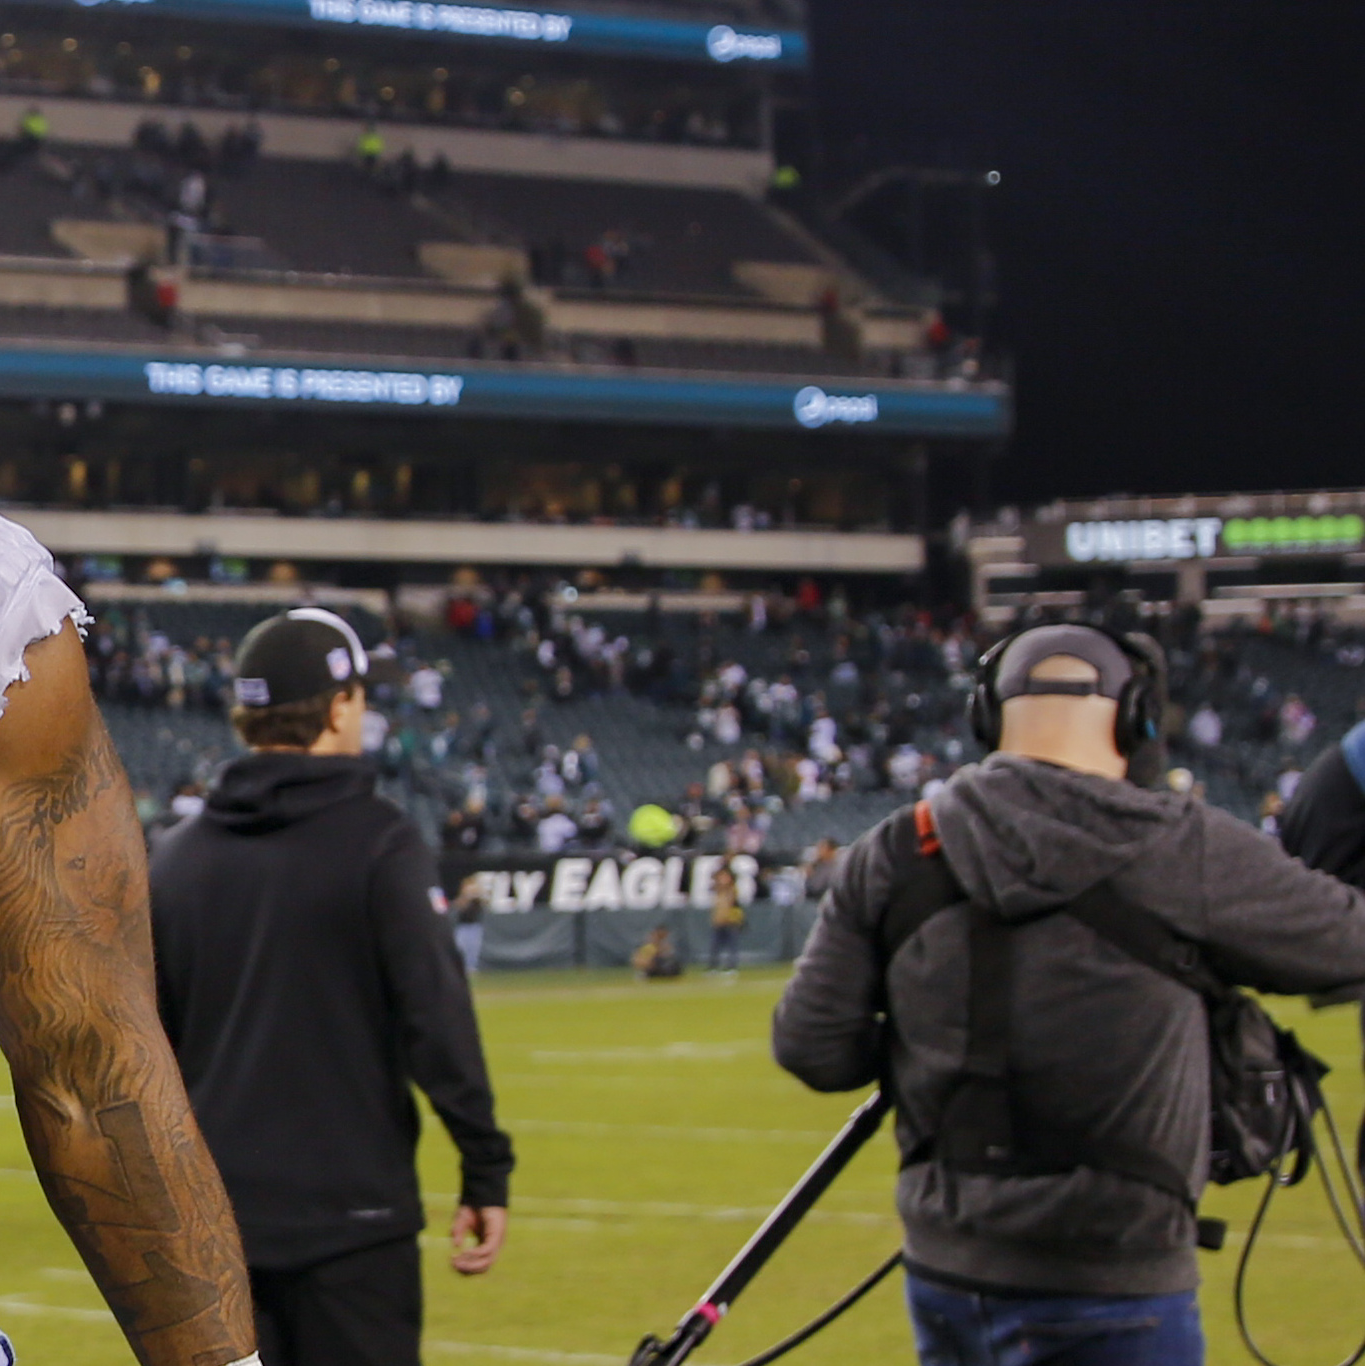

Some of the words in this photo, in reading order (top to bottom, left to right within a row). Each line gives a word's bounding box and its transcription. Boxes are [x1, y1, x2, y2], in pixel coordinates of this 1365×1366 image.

[144, 362, 203, 395] THIS
[204, 365, 272, 398] GAME
[300, 369, 428, 404] PRESENTED
[1067, 517, 1222, 562] UNIBET
[550, 854, 759, 912] EAGLES
